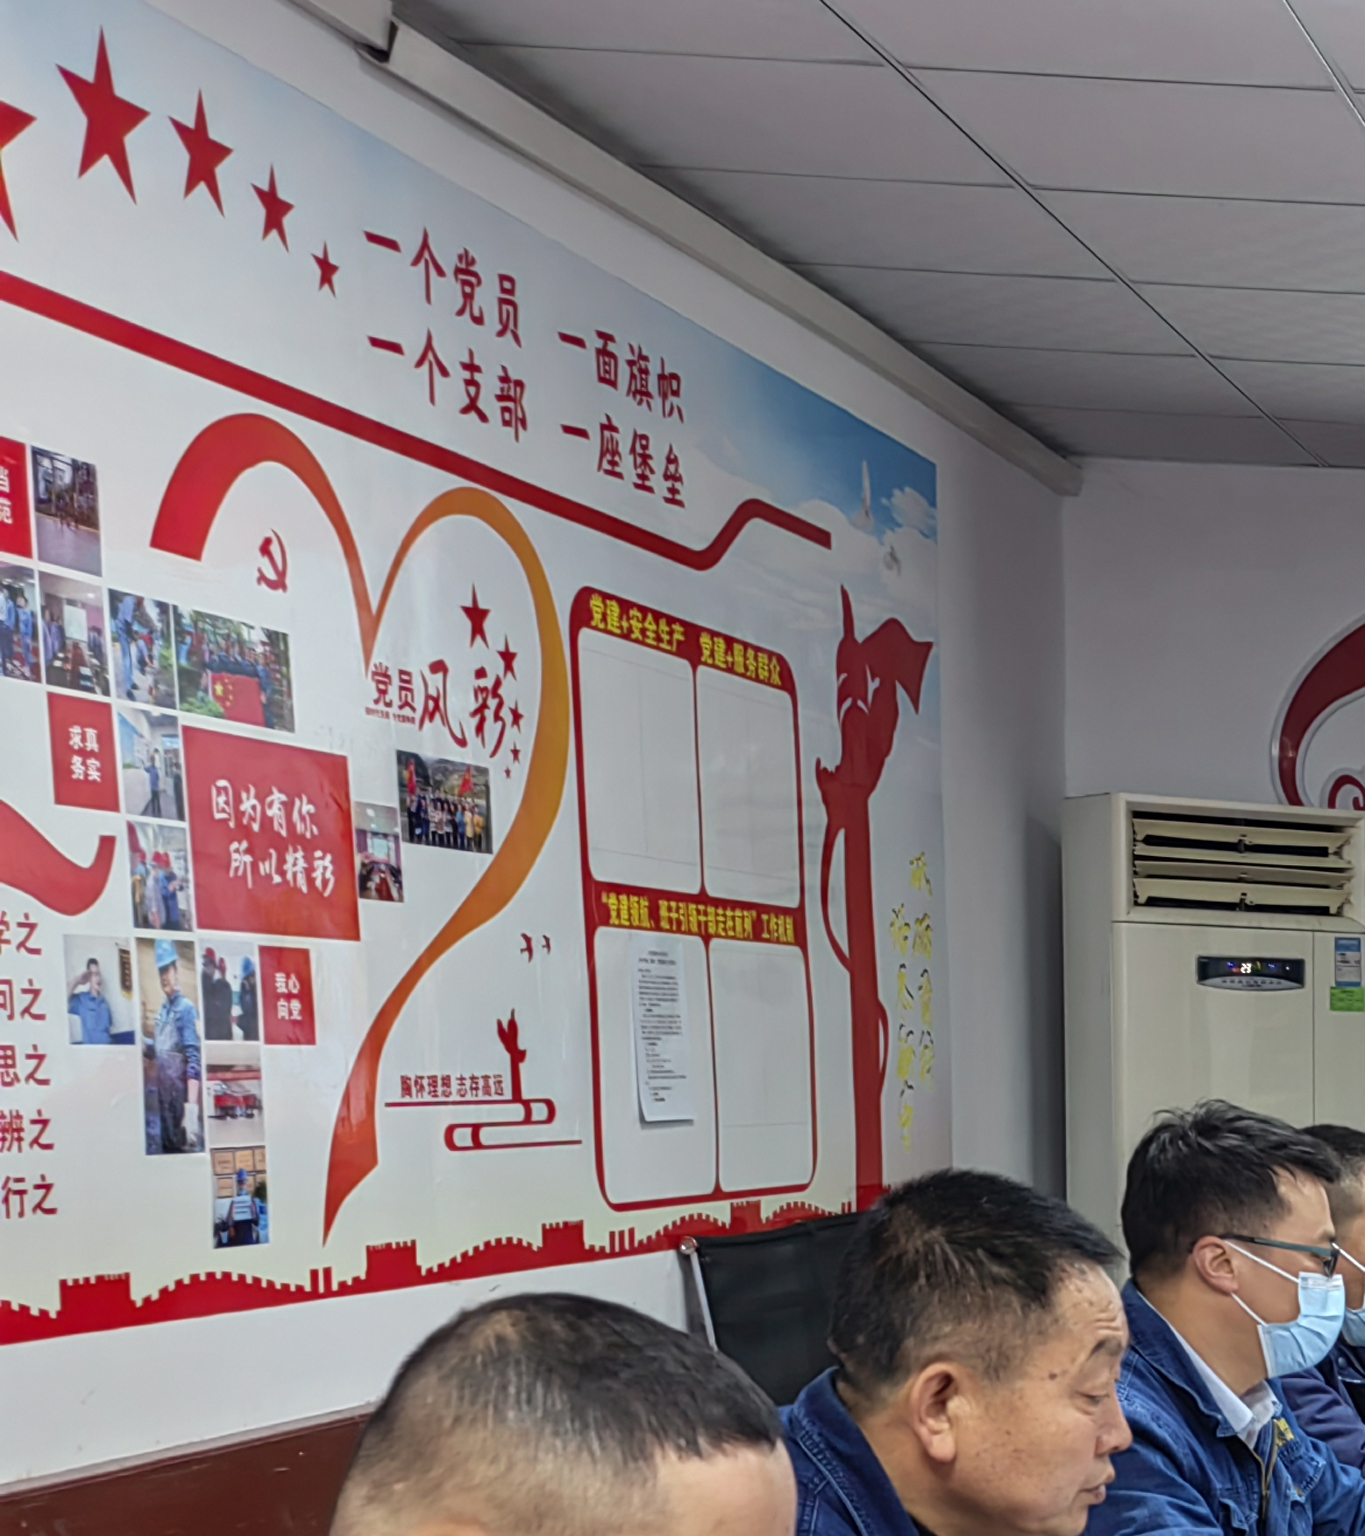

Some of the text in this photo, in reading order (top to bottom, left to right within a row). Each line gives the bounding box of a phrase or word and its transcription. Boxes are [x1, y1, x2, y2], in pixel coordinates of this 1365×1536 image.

[364, 226, 686, 425] 一个党员 一面旗帜
[367, 331, 687, 509] 一个支部 一座堡垒
[590, 593, 685, 652] 党建+安全生产
[700, 631, 782, 686] 党建+服务群众
[210, 778, 318, 840] 因为有你
[228, 840, 337, 900] 所以精彩
[400, 1073, 505, 1099] 胸怀理想 志存高远
[0, 1108, 56, 1154] 辨之
[1, 1174, 59, 1220] 行之
